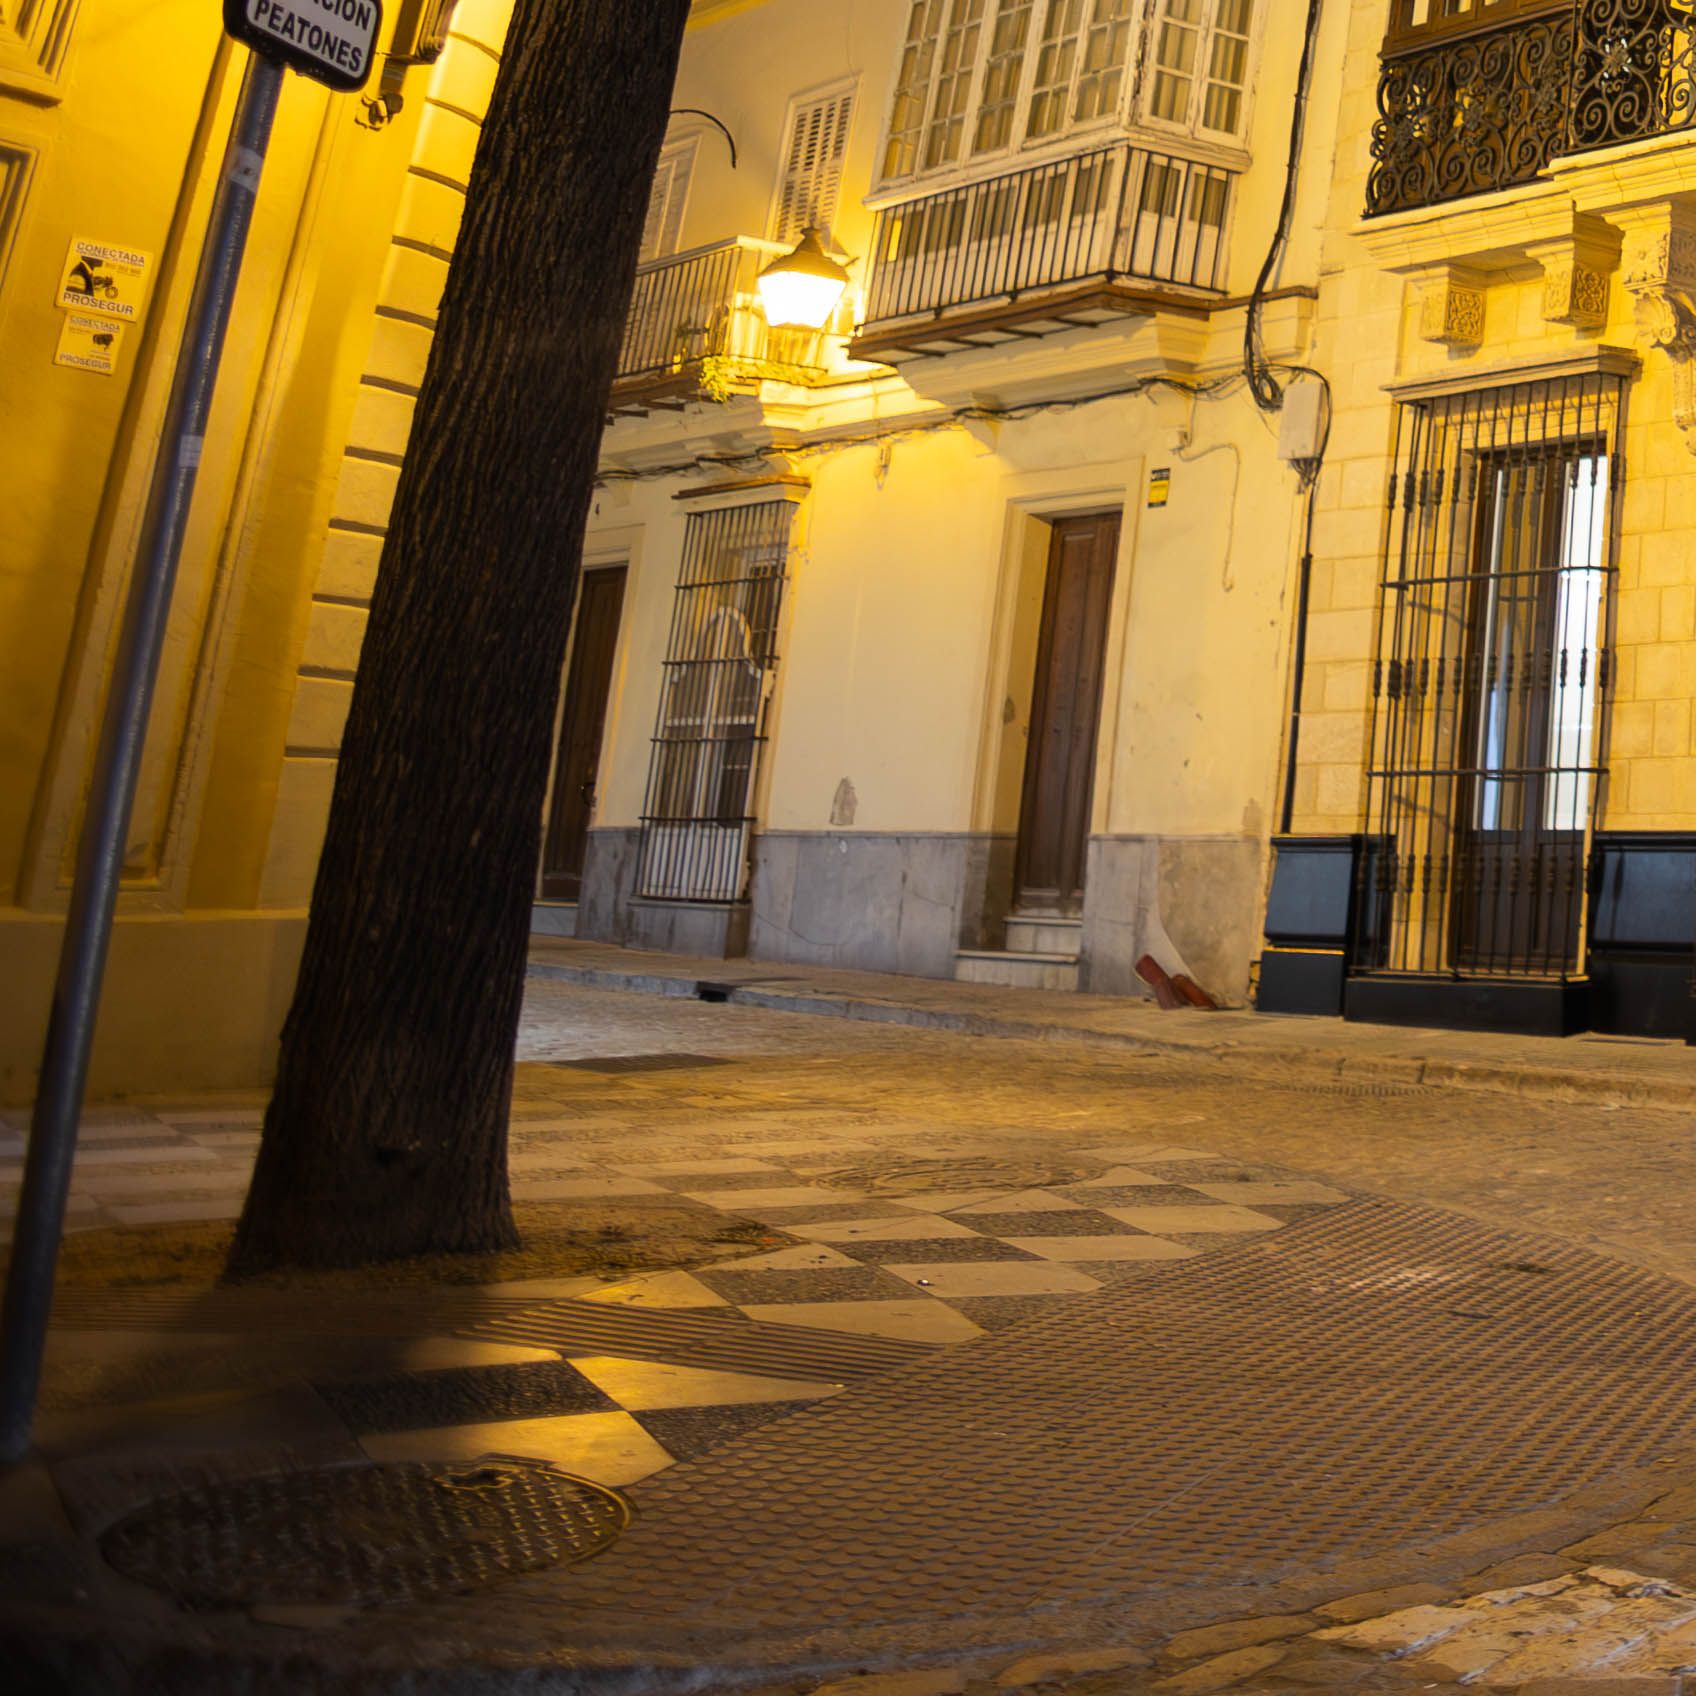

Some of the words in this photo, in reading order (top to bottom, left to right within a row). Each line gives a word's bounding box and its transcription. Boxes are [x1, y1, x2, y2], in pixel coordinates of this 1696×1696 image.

[76, 241, 145, 264] CONECTADA
[63, 292, 133, 315] PROSEGUR
[60, 352, 111, 370] PROSEGUR
